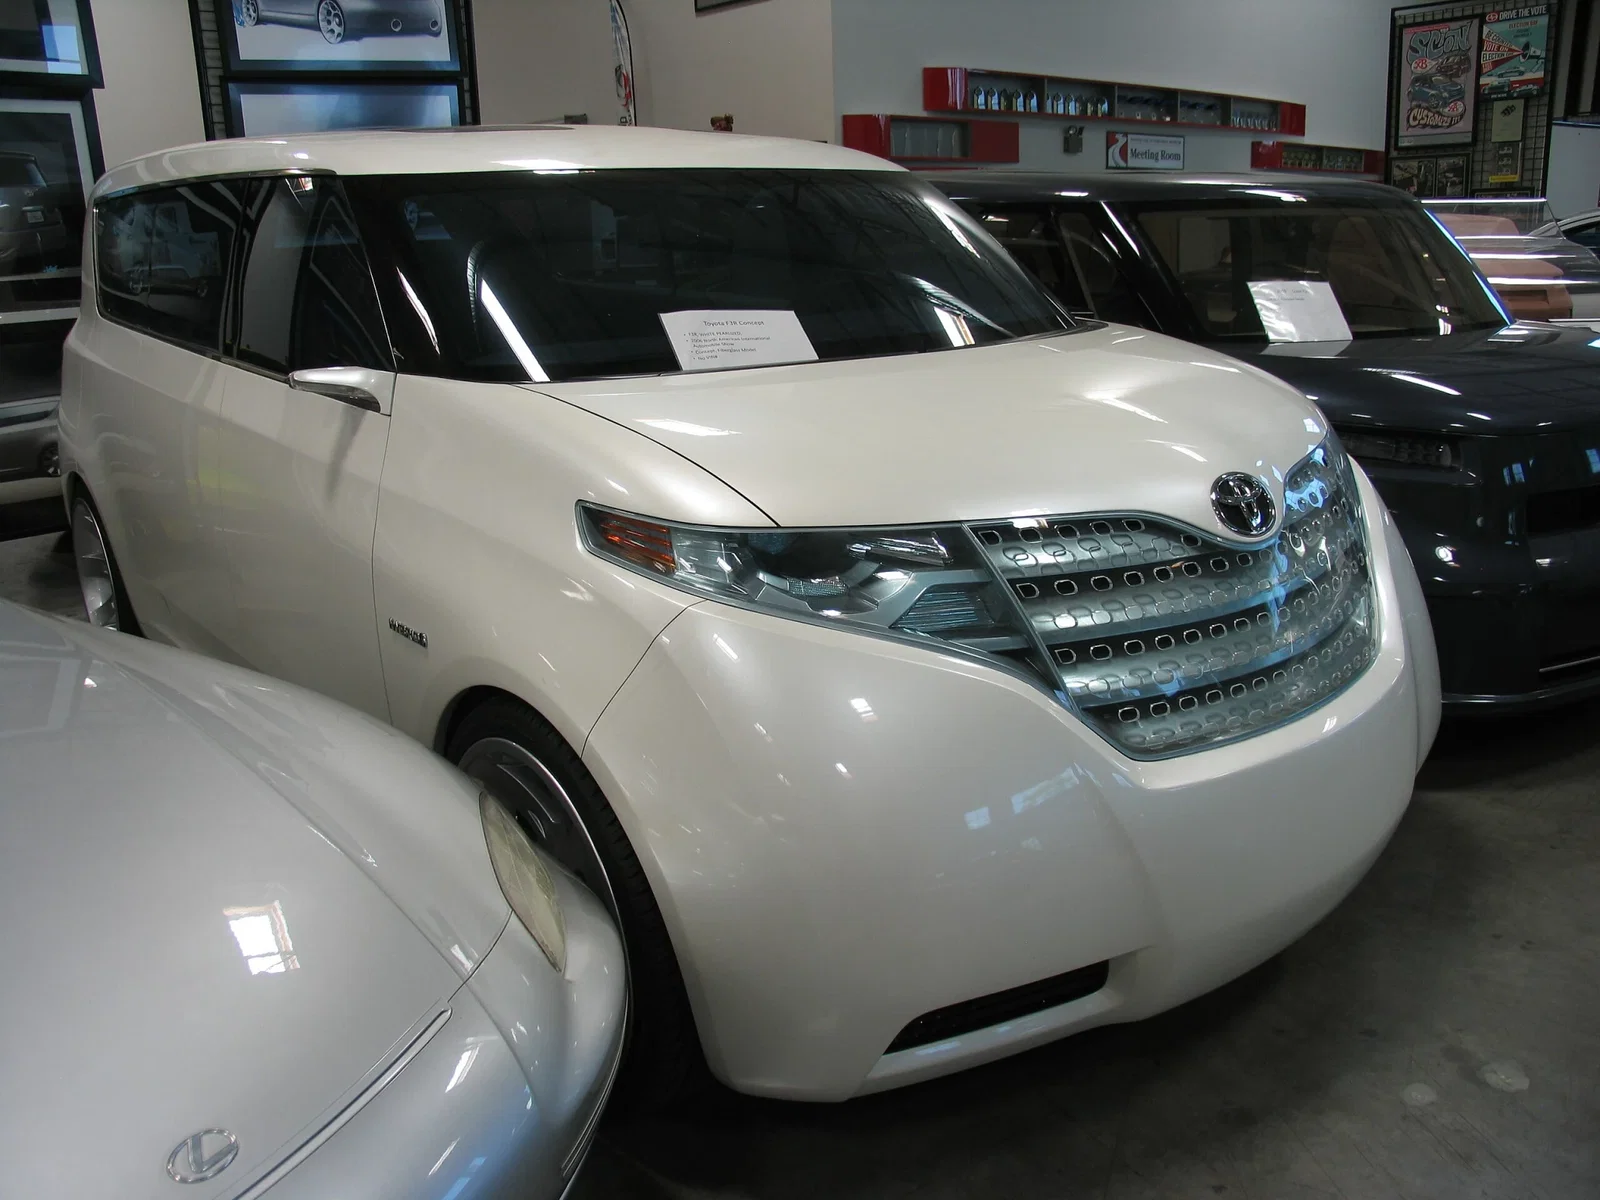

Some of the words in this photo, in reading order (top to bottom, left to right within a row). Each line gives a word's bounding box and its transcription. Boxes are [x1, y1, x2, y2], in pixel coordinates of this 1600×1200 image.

[1500, 10, 1517, 20] DRIVE
[1518, 7, 1530, 17] THE
[1531, 5, 1547, 15] VOTE
[1483, 41, 1499, 51] VOTE
[1482, 53, 1505, 62] ELECTION
[1130, 148, 1159, 163] Meeting
[1160, 149, 1181, 161] Room
